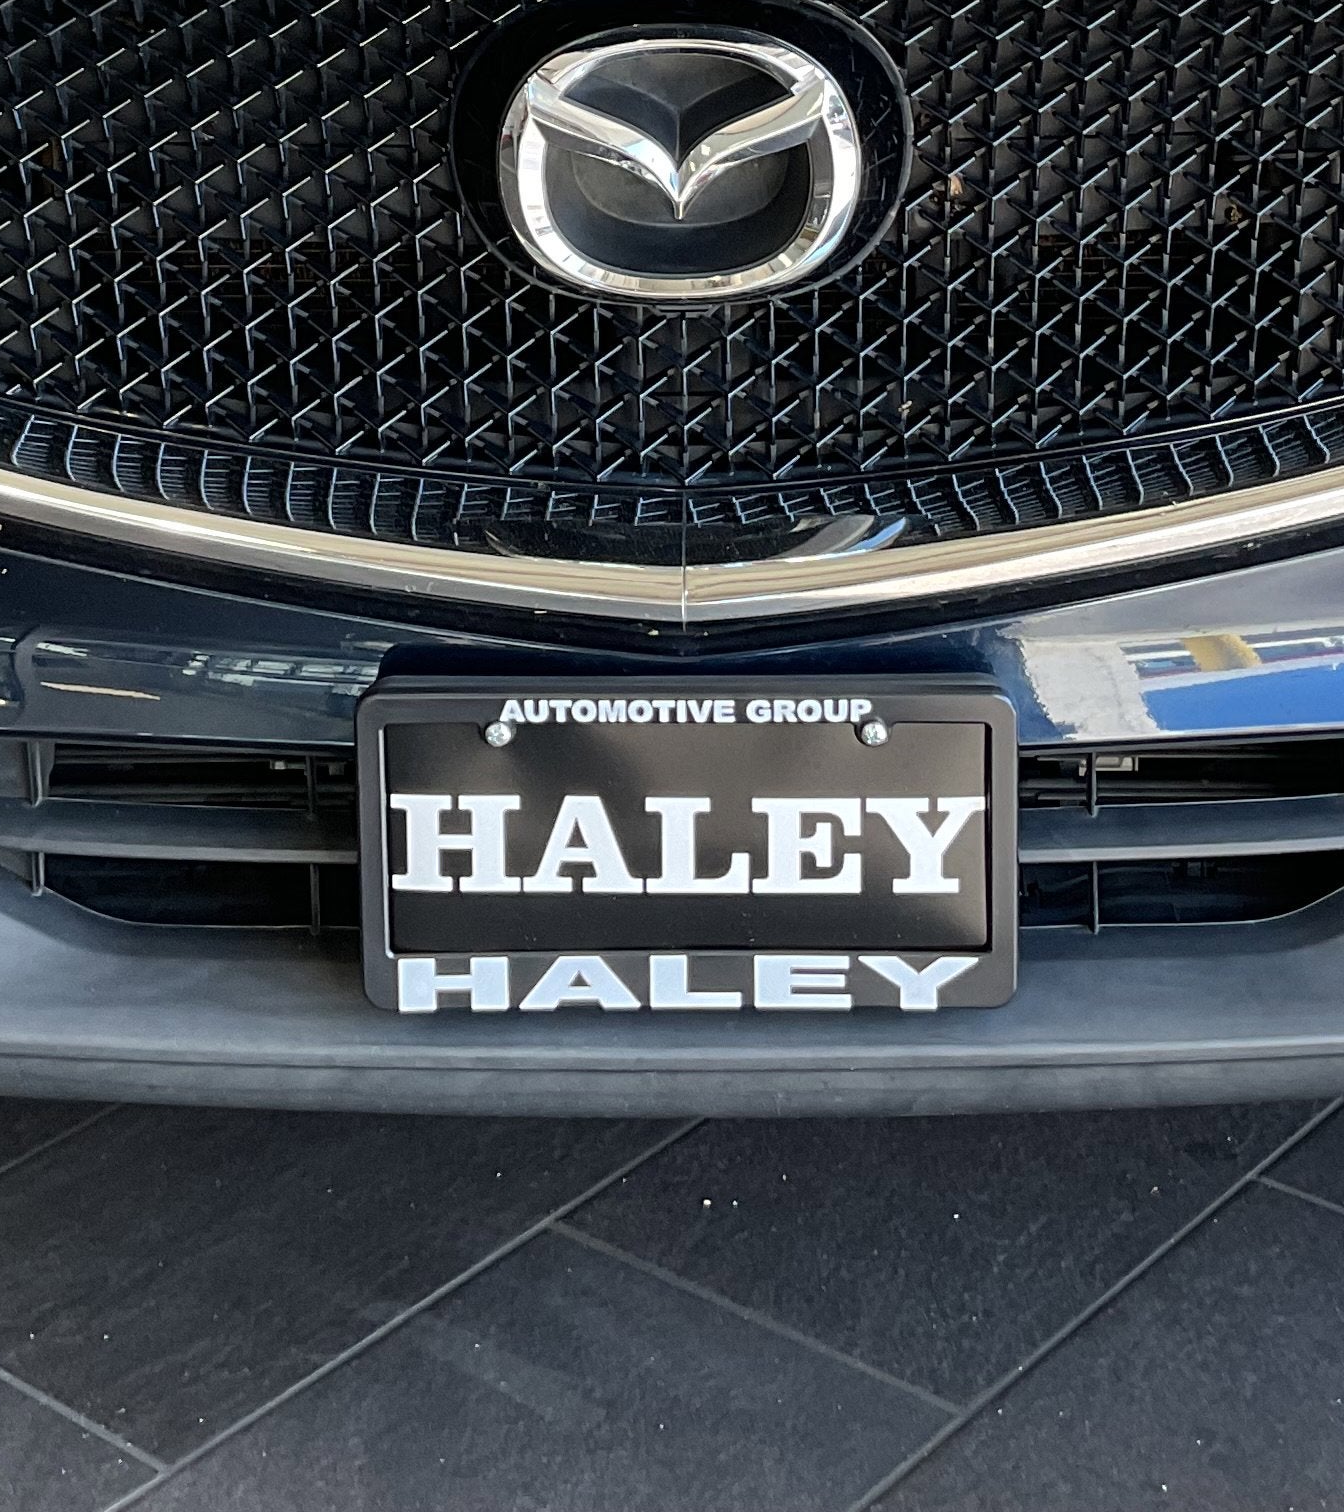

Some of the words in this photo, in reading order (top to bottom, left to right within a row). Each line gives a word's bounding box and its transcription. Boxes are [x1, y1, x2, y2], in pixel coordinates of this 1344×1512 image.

[500, 698, 736, 724] AUTOMOTIVE
[746, 698, 873, 724] GROUP
[390, 793, 986, 895] HALEY
[397, 954, 980, 1013] HALEY
